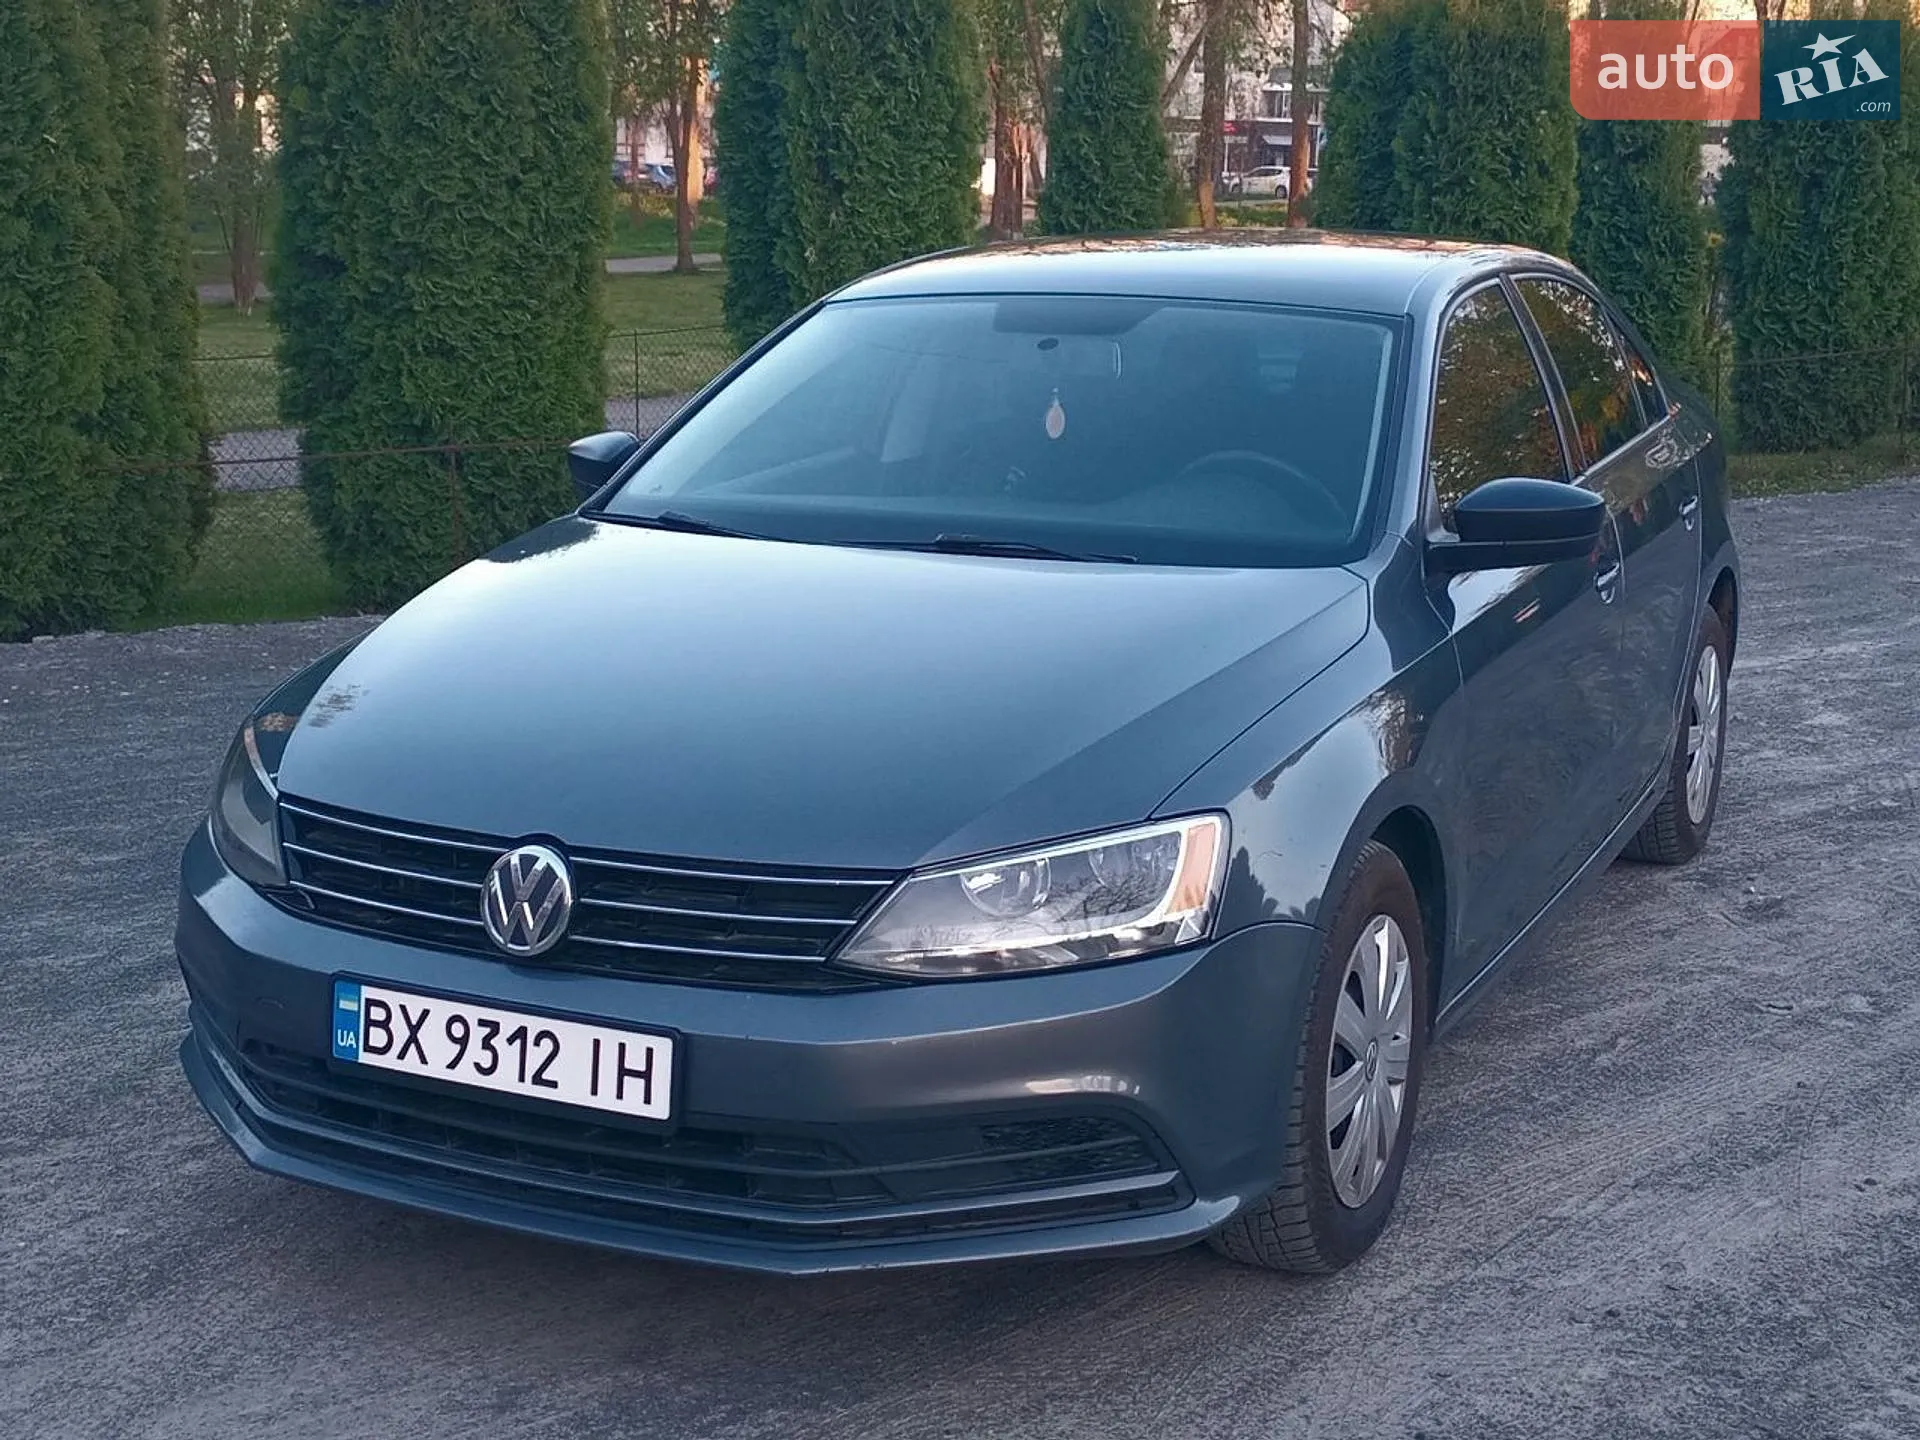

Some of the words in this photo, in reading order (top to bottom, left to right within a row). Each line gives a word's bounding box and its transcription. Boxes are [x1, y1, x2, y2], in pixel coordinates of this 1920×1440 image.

[482, 846, 572, 956] VW
[337, 1028, 357, 1049] UA
[363, 997, 432, 1066] BX
[445, 1014, 561, 1090] 9312
[590, 1038, 654, 1106] IH
